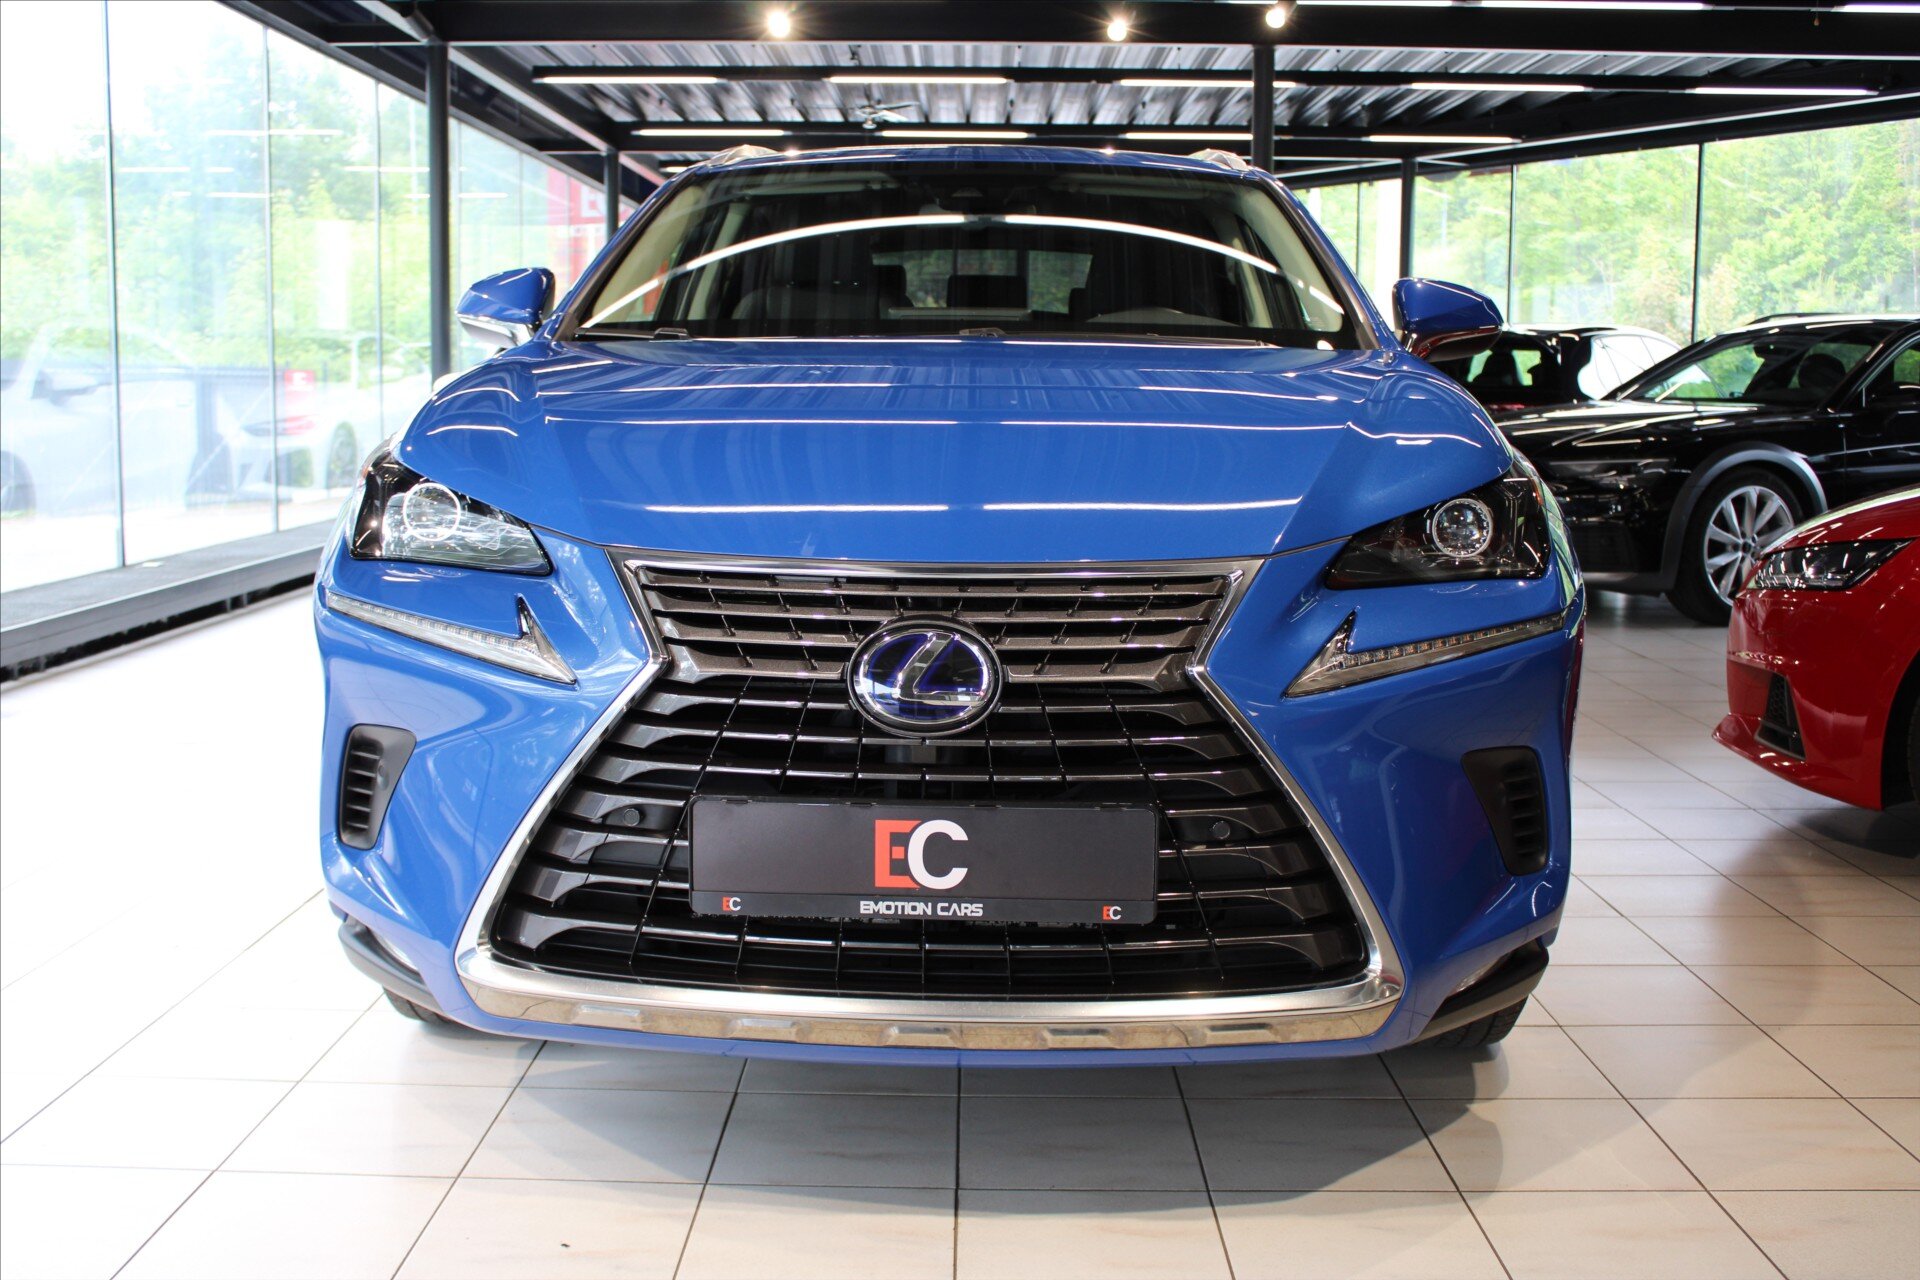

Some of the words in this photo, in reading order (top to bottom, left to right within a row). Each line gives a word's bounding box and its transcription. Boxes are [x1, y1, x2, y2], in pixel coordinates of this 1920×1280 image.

[874, 819, 968, 890] EC
[722, 896, 741, 911] EC
[859, 901, 932, 916] EMOTION
[936, 903, 984, 917] CARS
[1103, 905, 1122, 920] EC
